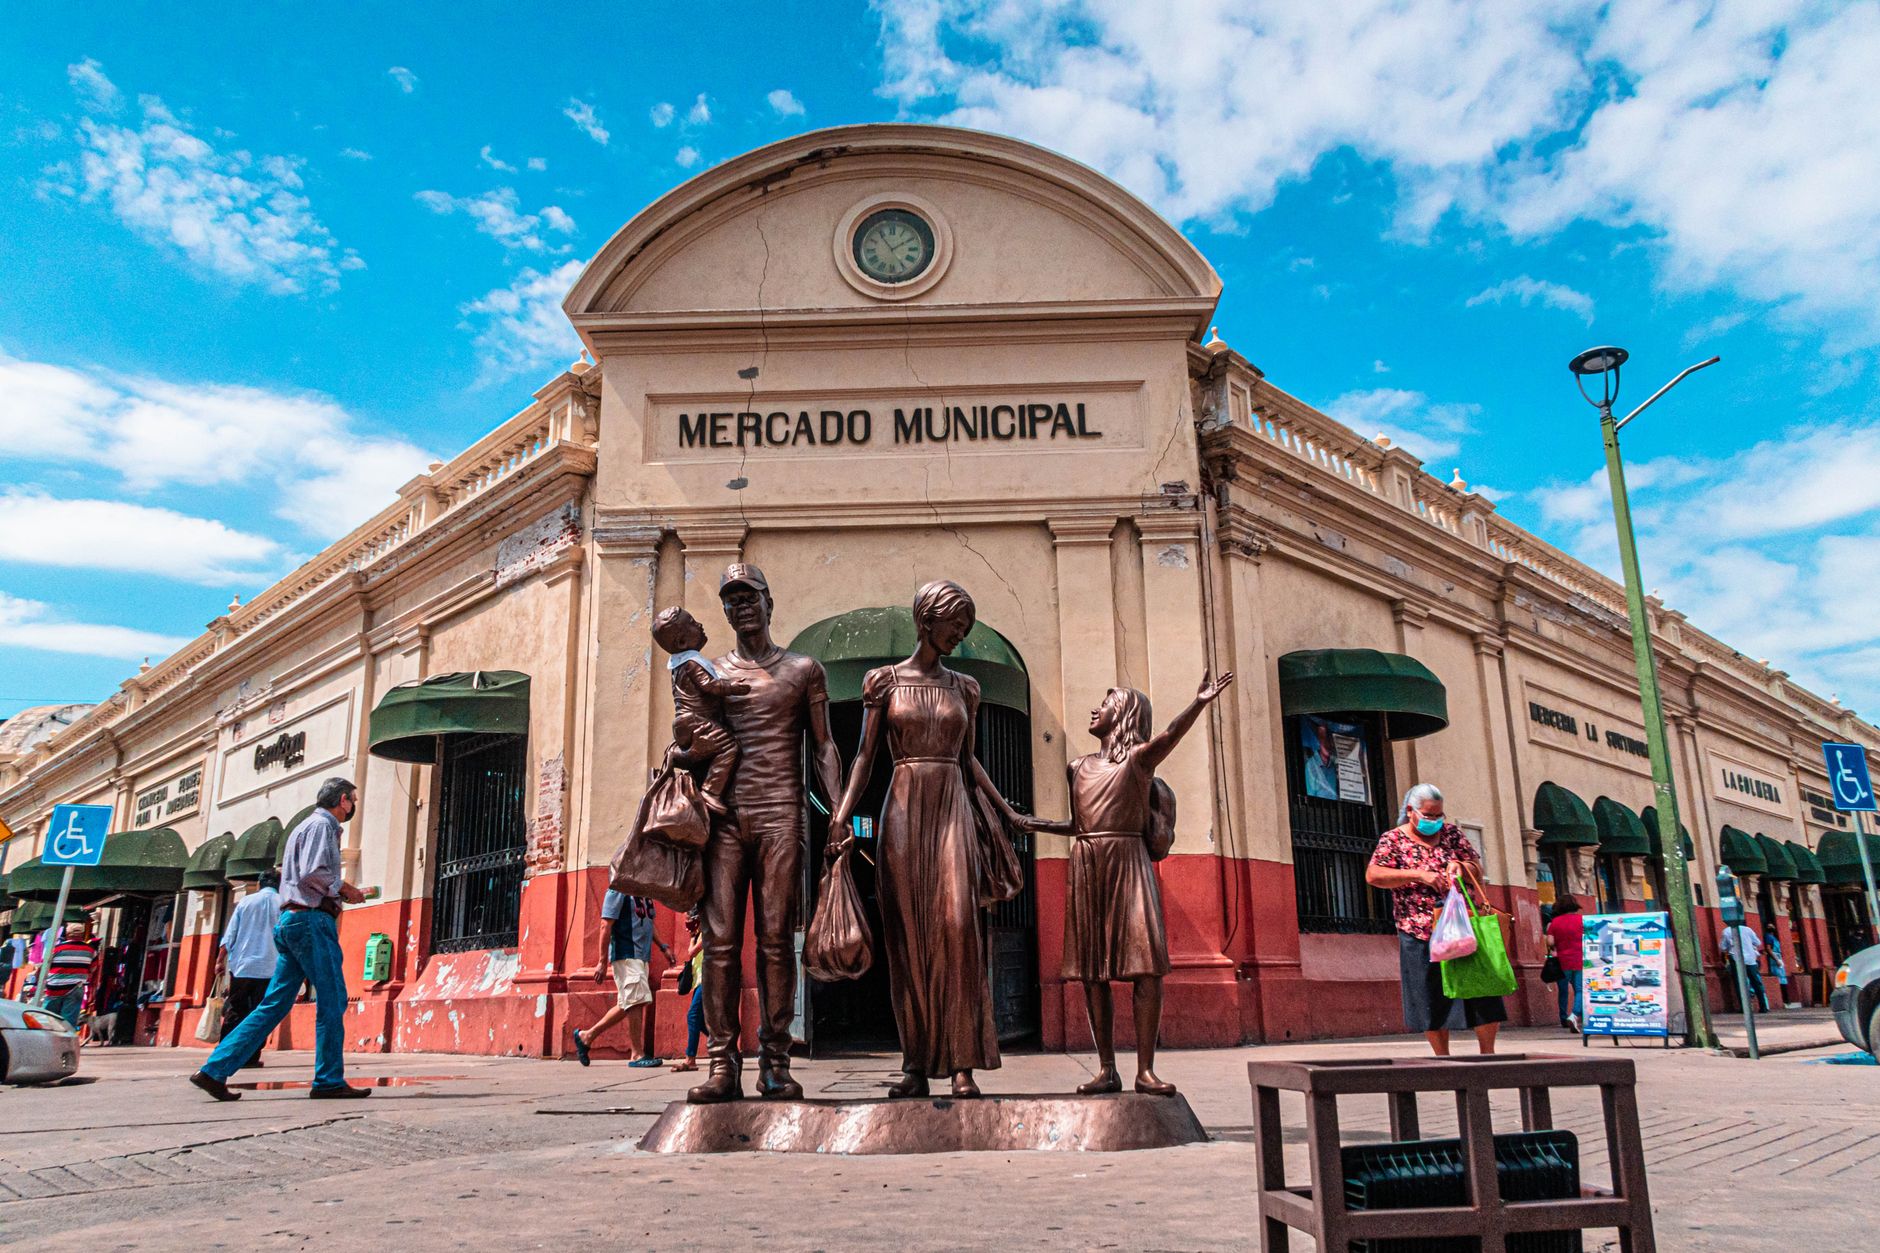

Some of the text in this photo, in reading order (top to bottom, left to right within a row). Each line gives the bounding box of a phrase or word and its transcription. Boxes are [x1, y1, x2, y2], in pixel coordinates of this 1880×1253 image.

[679, 402, 1102, 448] MERCADO MUNICIPAL
[1585, 722, 1598, 742] LA
